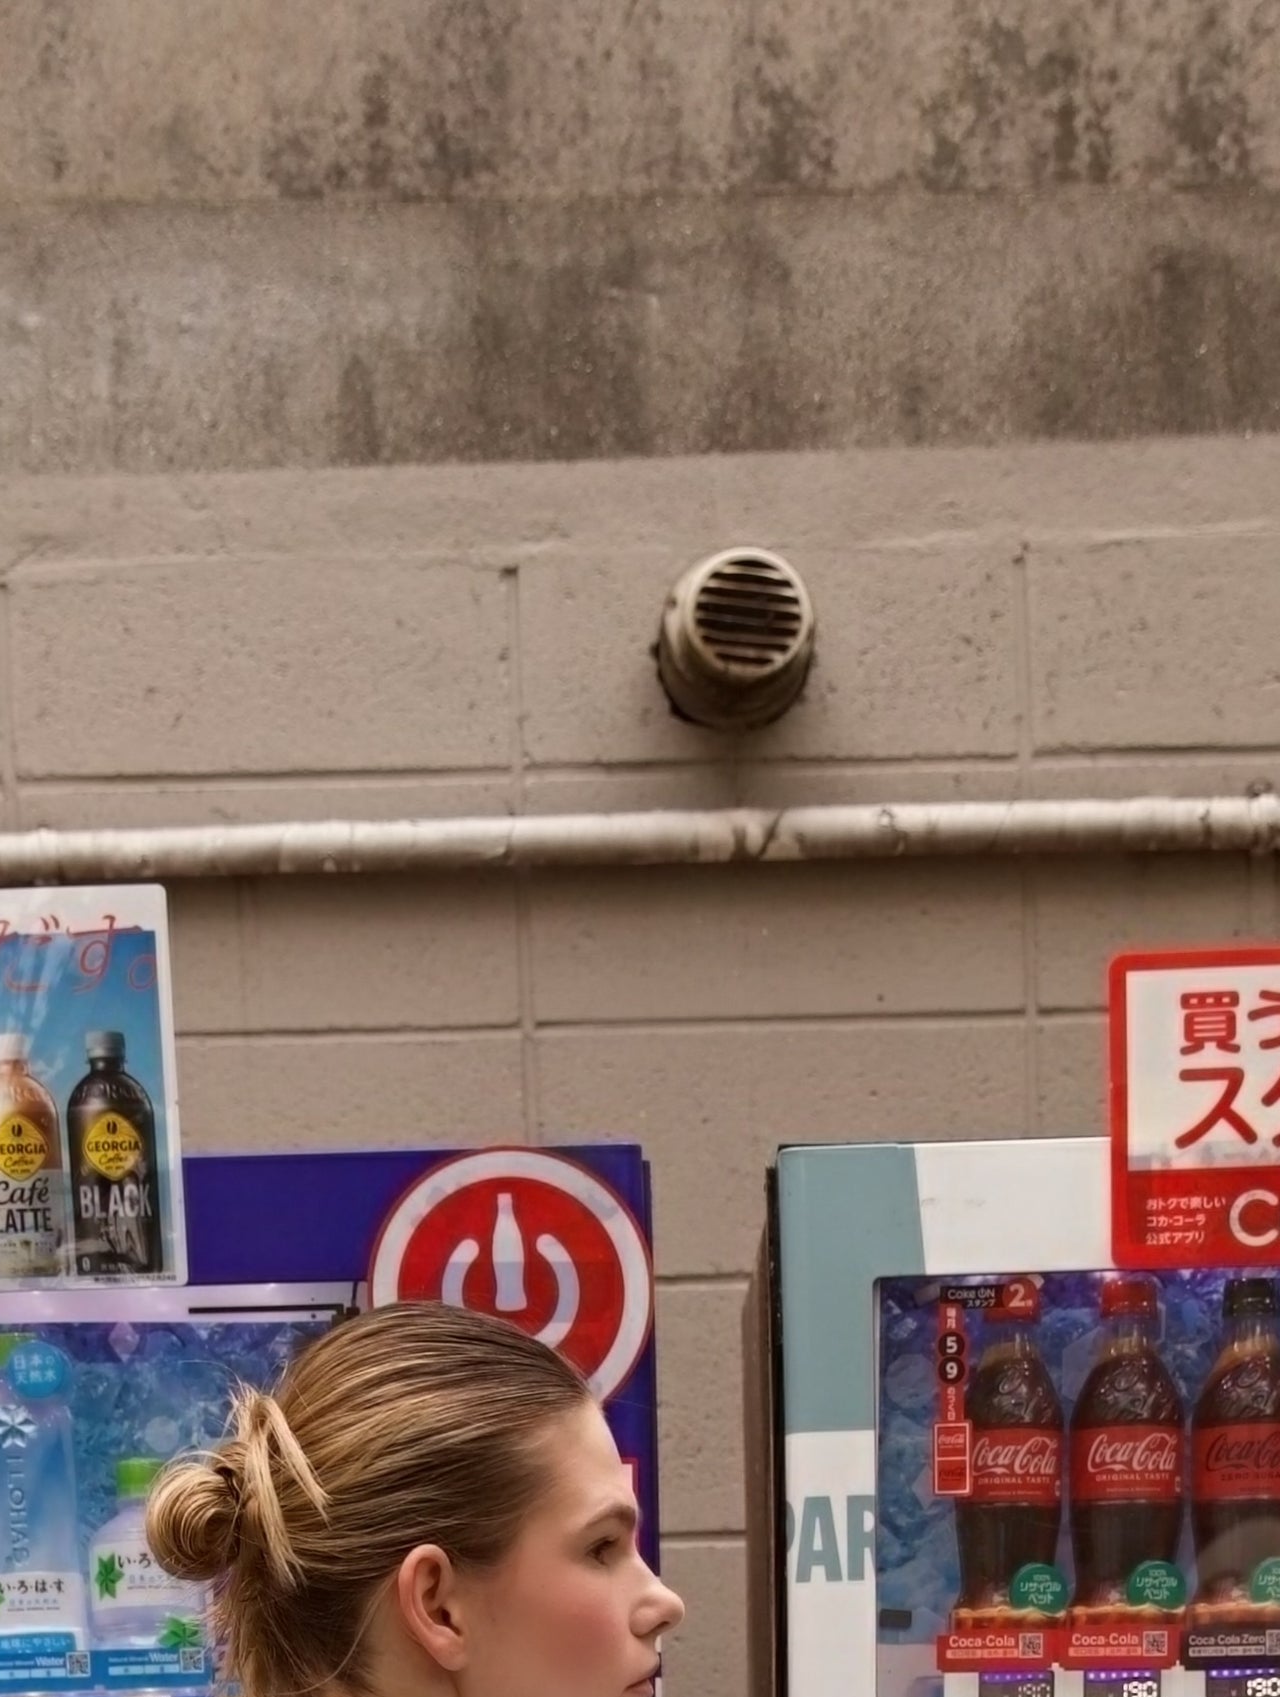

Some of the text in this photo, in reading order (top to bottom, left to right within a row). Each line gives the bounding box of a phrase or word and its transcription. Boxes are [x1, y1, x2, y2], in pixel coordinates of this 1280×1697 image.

[79, 1184, 152, 1219] BLACK
[1145, 1195, 1226, 1212] おトクで楽しい
[945, 1336, 959, 1354] 5
[945, 1361, 959, 1380] 9
[787, 1494, 875, 1584] AR
[948, 1635, 1017, 1648] Coca-Cola
